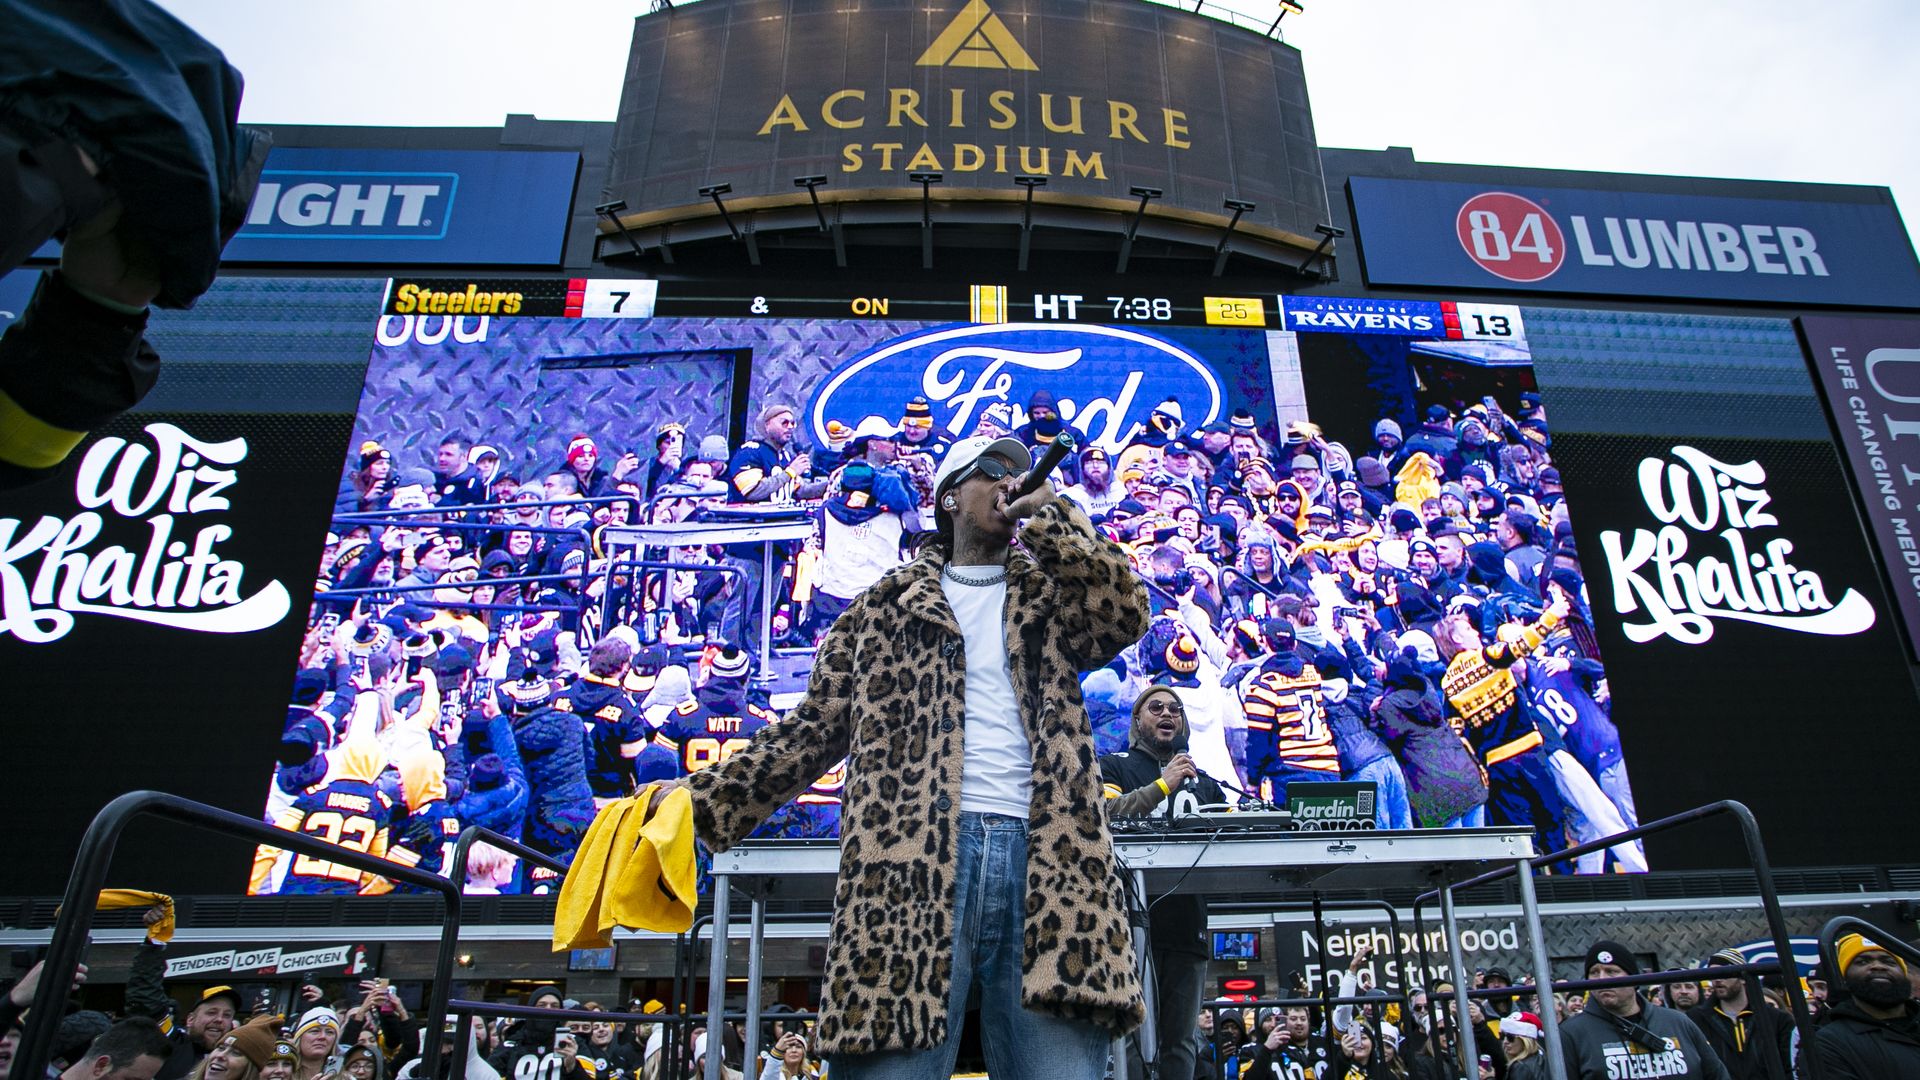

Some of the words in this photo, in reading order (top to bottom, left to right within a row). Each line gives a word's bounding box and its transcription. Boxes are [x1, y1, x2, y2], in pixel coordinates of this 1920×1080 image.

[757, 87, 1192, 150] ACRISURE
[842, 141, 1109, 180] STADIUM
[247, 182, 441, 227] IGHT
[1468, 209, 1555, 263] 84
[1570, 215, 1831, 276] LUMBER
[395, 283, 523, 314] Steelers
[609, 291, 631, 313] 7
[750, 296, 769, 314] &
[851, 297, 889, 316] ON
[1034, 294, 1084, 319] HT
[1107, 296, 1172, 320] 7:38
[1219, 302, 1248, 320] 25
[1316, 304, 1407, 314] BALTIMORE
[1289, 310, 1434, 331] RAVENS
[1471, 314, 1512, 337] 13
[922, 346, 1141, 456] Fd
[75, 422, 248, 517] Wiz
[1830, 346, 1860, 390] LIFE
[1849, 395, 1902, 511] CHANGING
[1890, 517, 1920, 598] MEDIC
[1637, 445, 1779, 532] Wiz
[0, 511, 291, 643] Khalifa
[1600, 524, 1877, 644] Khalifa
[707, 717, 743, 733] WATT
[1293, 799, 1355, 819] Jardín
[170, 955, 231, 972] TENDERS
[236, 951, 276, 968] LOVE
[282, 951, 343, 970] CHICKEN
[1304, 961, 1376, 992] Fod
[1605, 1049, 1688, 1080] STEELERS
